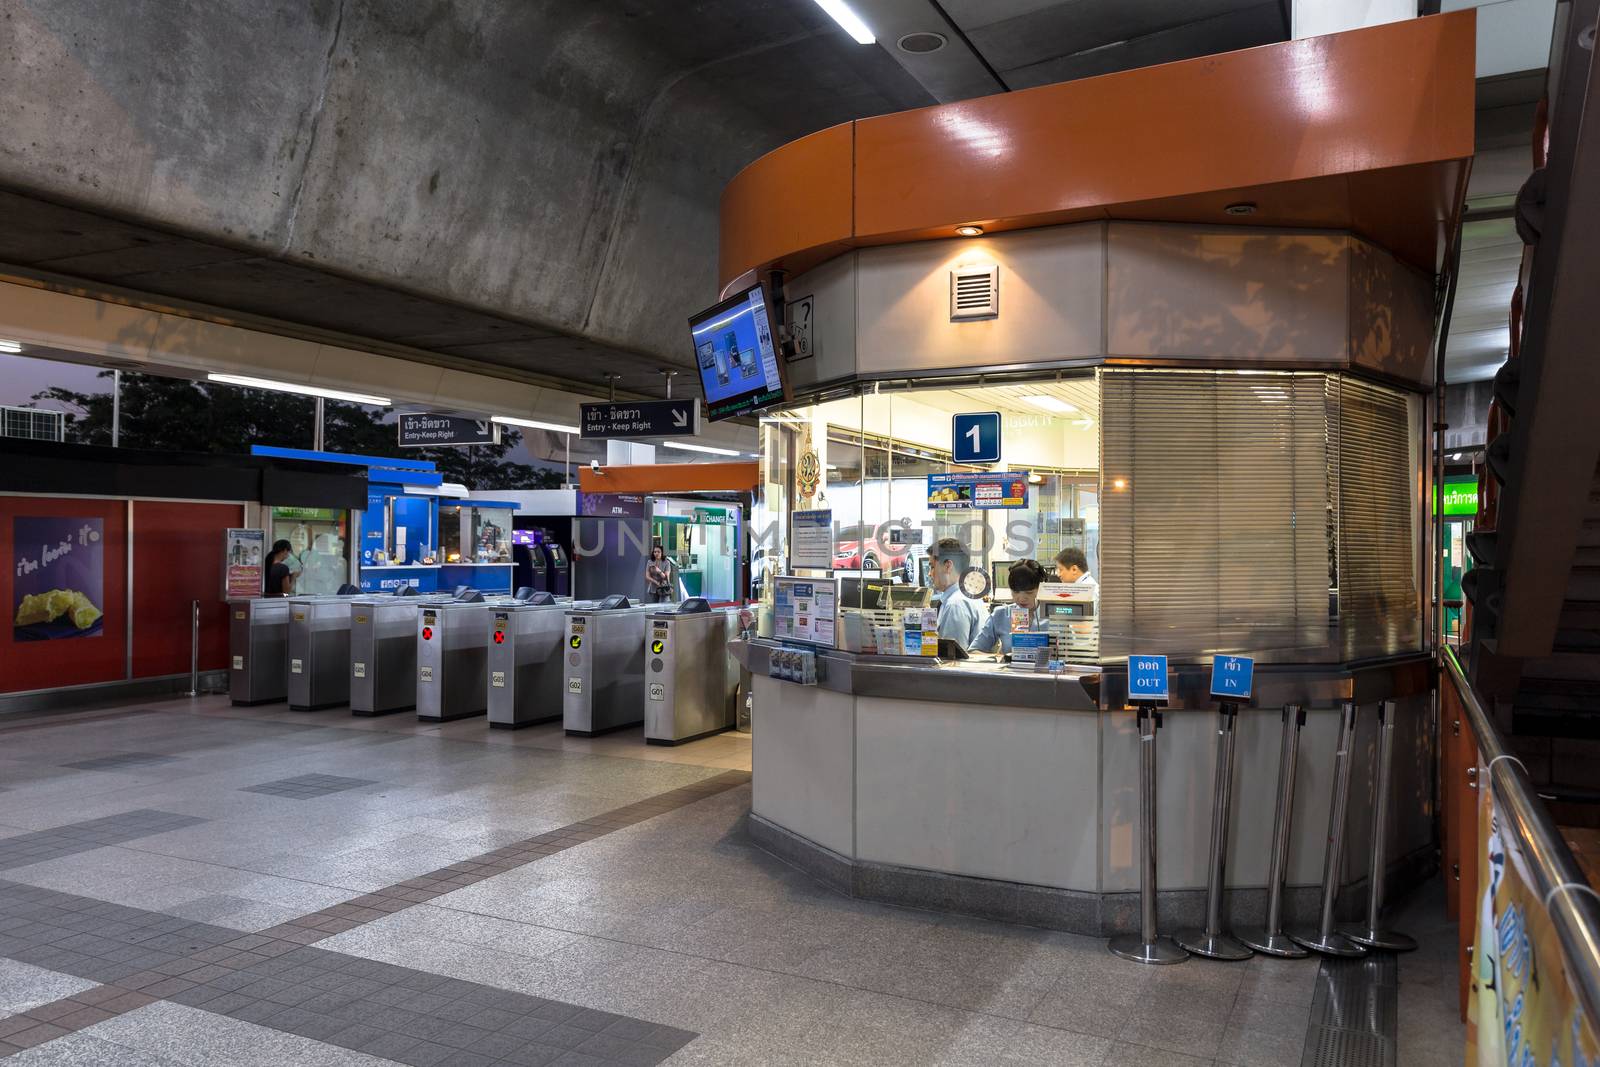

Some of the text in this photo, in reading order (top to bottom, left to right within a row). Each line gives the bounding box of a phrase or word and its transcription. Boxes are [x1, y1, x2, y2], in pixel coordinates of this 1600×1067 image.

[587, 423, 606, 432] Entry
[612, 422, 630, 432] Keep
[632, 421, 651, 431] Right
[438, 430, 454, 439] Right
[965, 424, 981, 453] 1
[611, 506, 623, 514] ATM
[1137, 661, 1160, 671] ออก
[1224, 658, 1241, 672] เข้า
[569, 681, 581, 689] G02
[1136, 678, 1161, 688] OUT
[1224, 678, 1238, 688] IN
[651, 688, 663, 696] G01
